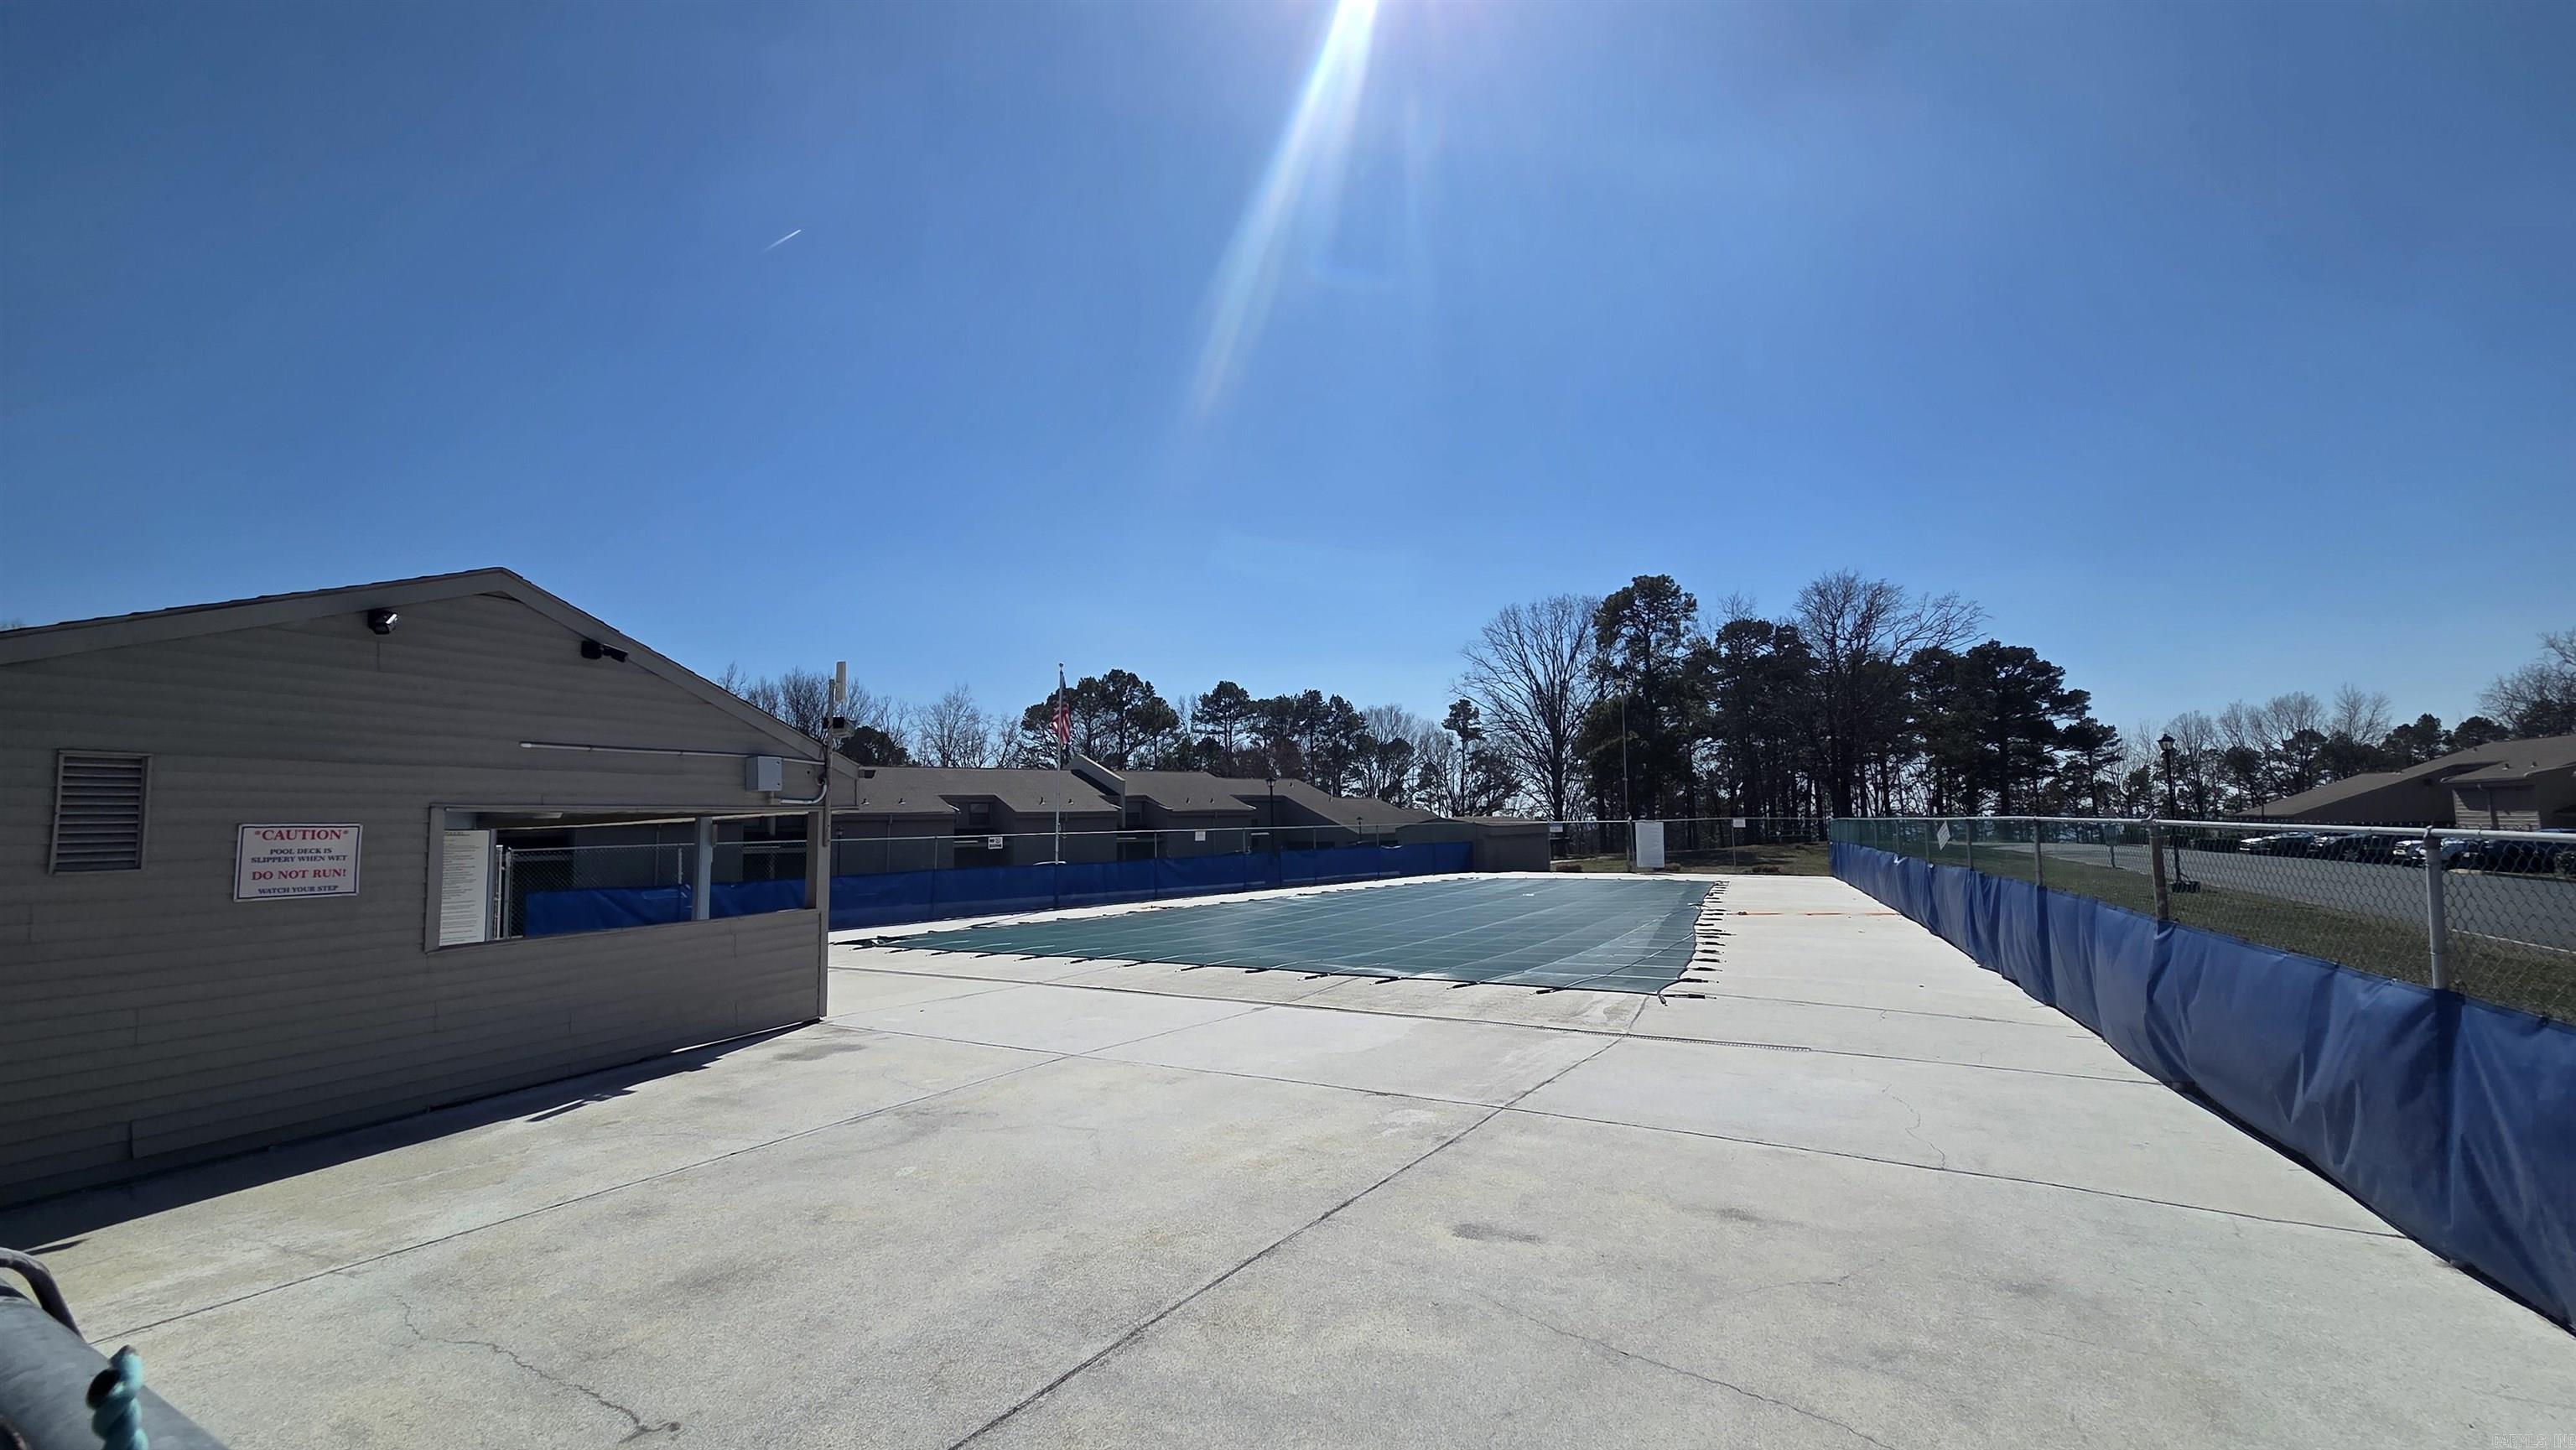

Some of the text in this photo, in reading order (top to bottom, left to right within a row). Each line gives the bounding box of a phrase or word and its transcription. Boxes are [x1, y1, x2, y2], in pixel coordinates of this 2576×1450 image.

[252, 869, 346, 881] DO NOT RUN!
